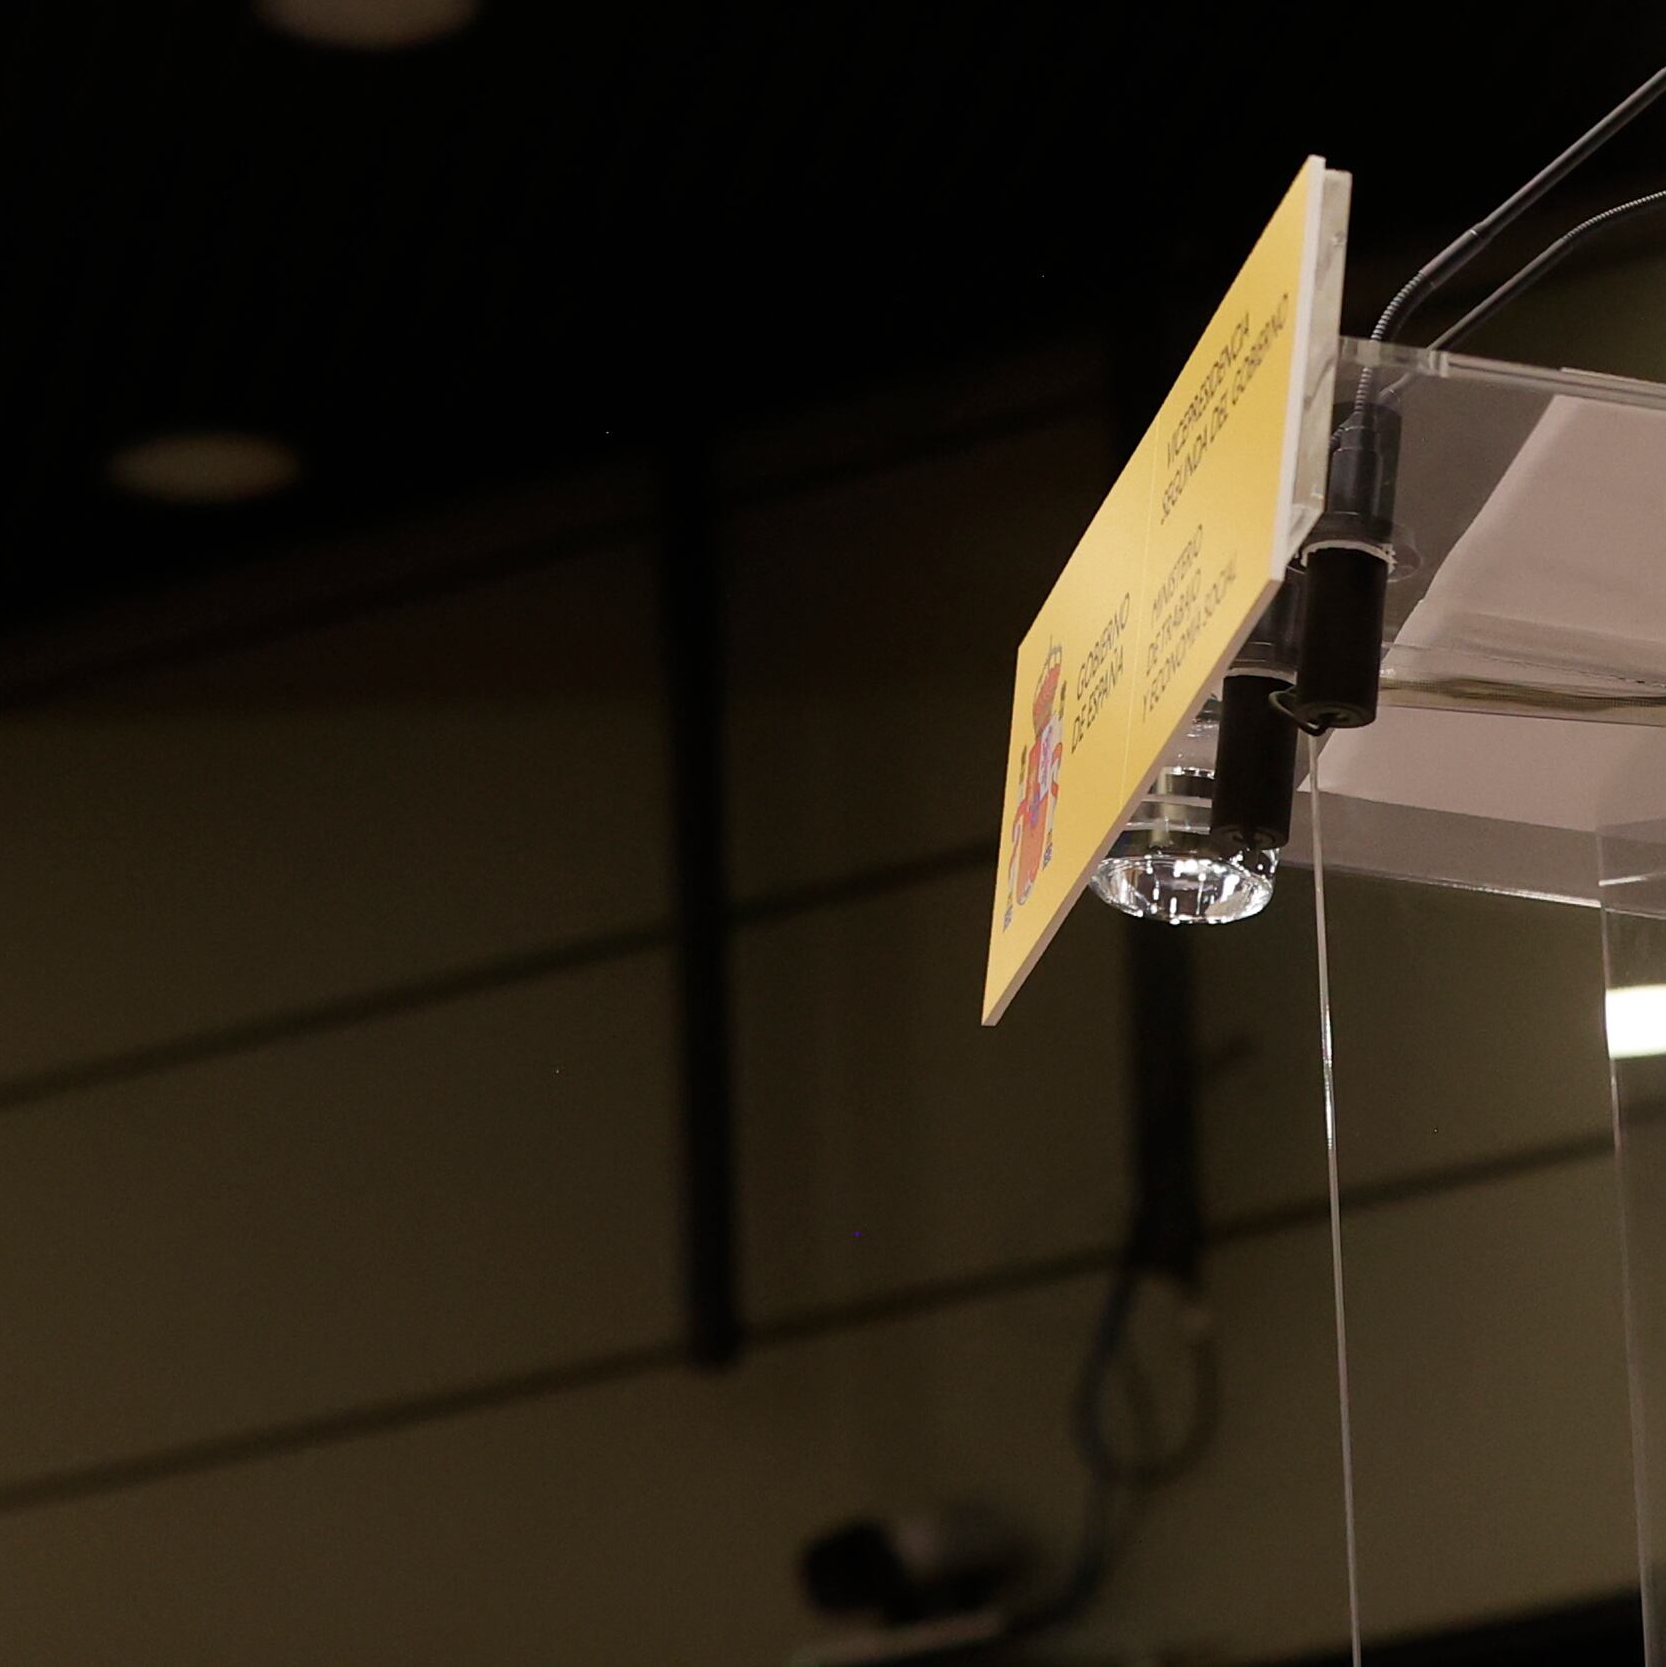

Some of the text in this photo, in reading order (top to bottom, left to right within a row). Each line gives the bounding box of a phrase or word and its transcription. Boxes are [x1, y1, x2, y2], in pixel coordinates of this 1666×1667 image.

[1160, 292, 1289, 525] SEGUNDA DEL GOBIERNO
[1166, 310, 1250, 470] VICEPRESIDENCIA
[1146, 568, 1202, 677] DE TRABAJO
[1150, 523, 1203, 630] MINISTERIO
[1071, 646, 1123, 755] DE ESPAÑA
[1077, 592, 1130, 701] GOBIERNO
